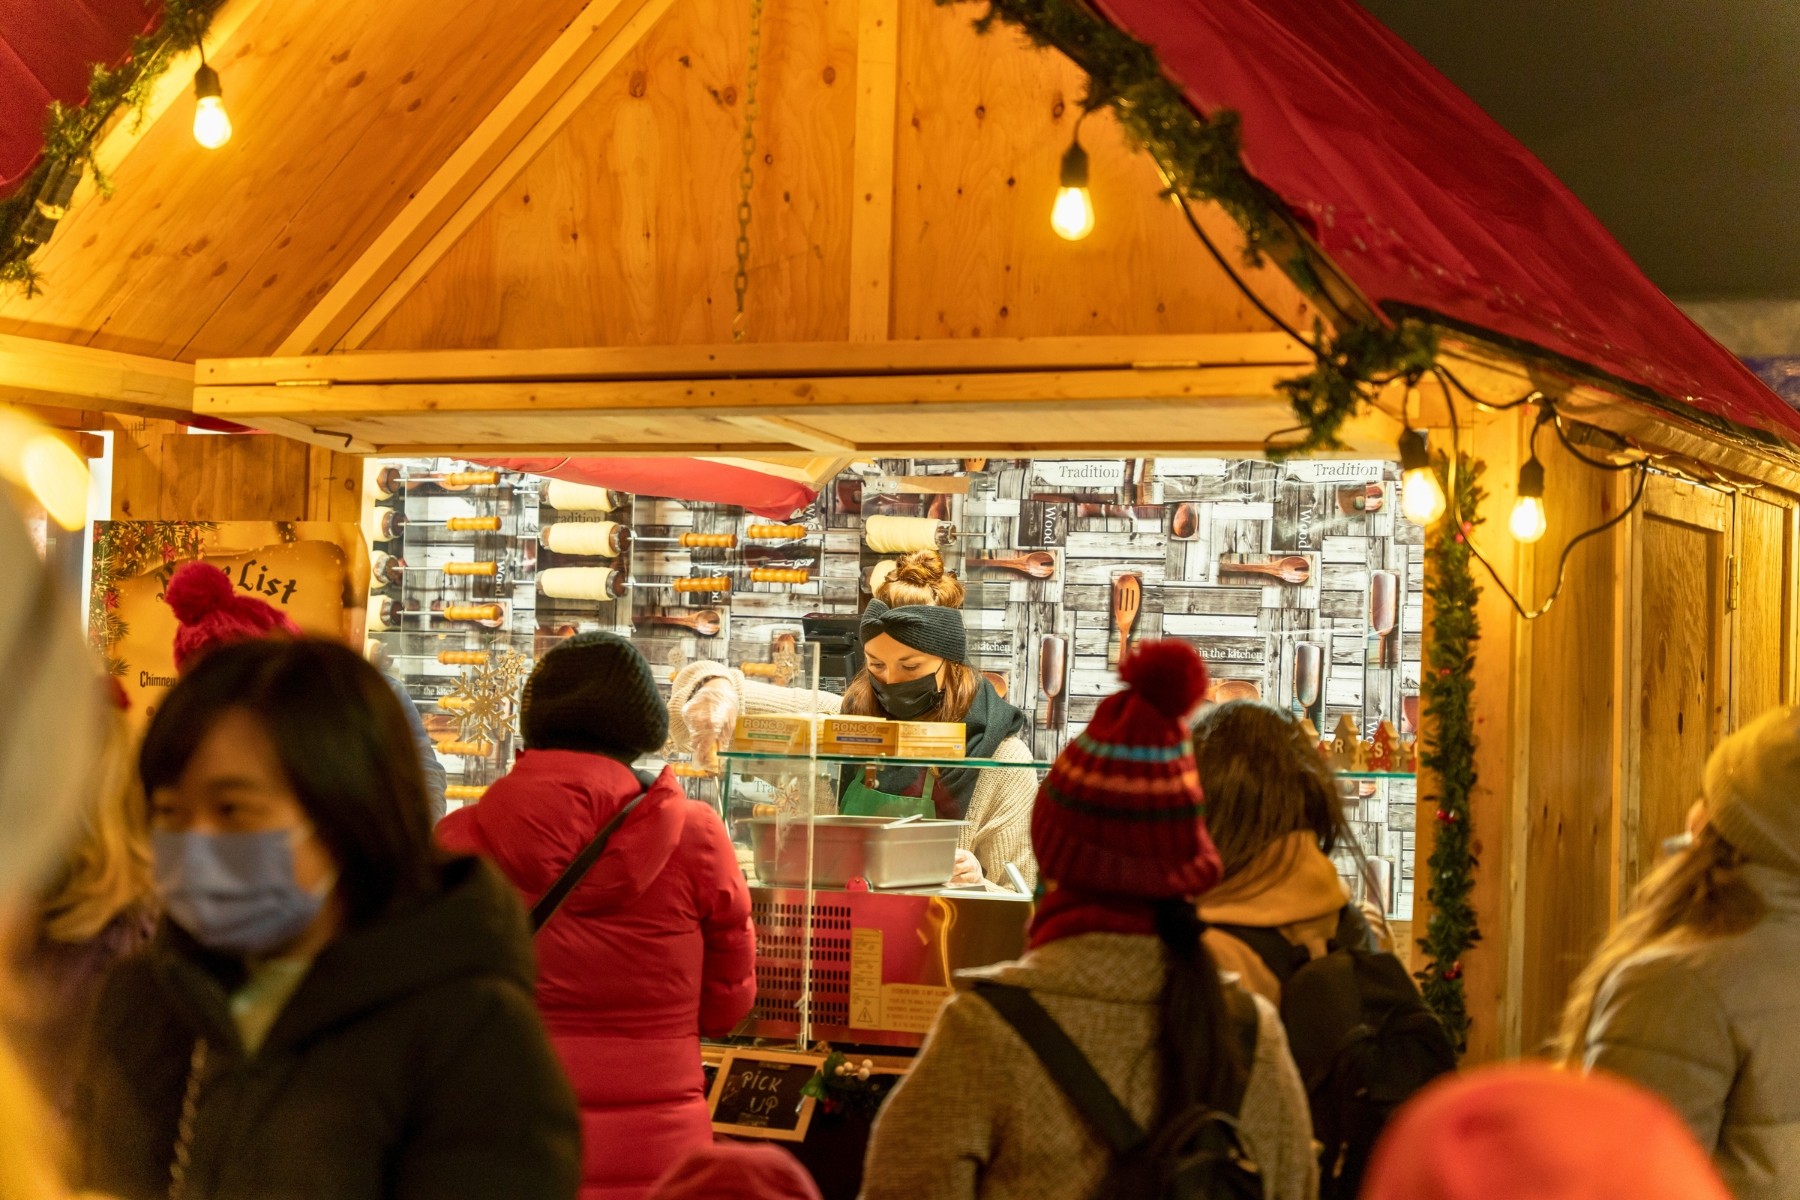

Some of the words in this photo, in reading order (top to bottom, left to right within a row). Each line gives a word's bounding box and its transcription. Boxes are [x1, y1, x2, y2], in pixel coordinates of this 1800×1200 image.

[1059, 464, 1120, 478] Tradition
[1313, 462, 1378, 477] Tradition
[1043, 505, 1057, 545] Wood
[1298, 509, 1313, 549] Wood
[237, 559, 298, 605] List
[1198, 647, 1208, 658] in
[1210, 647, 1226, 658] the
[1227, 647, 1263, 659] kitchen
[743, 718, 785, 731] RONCO
[831, 721, 876, 734] RONCO
[750, 1095, 779, 1115] UP
